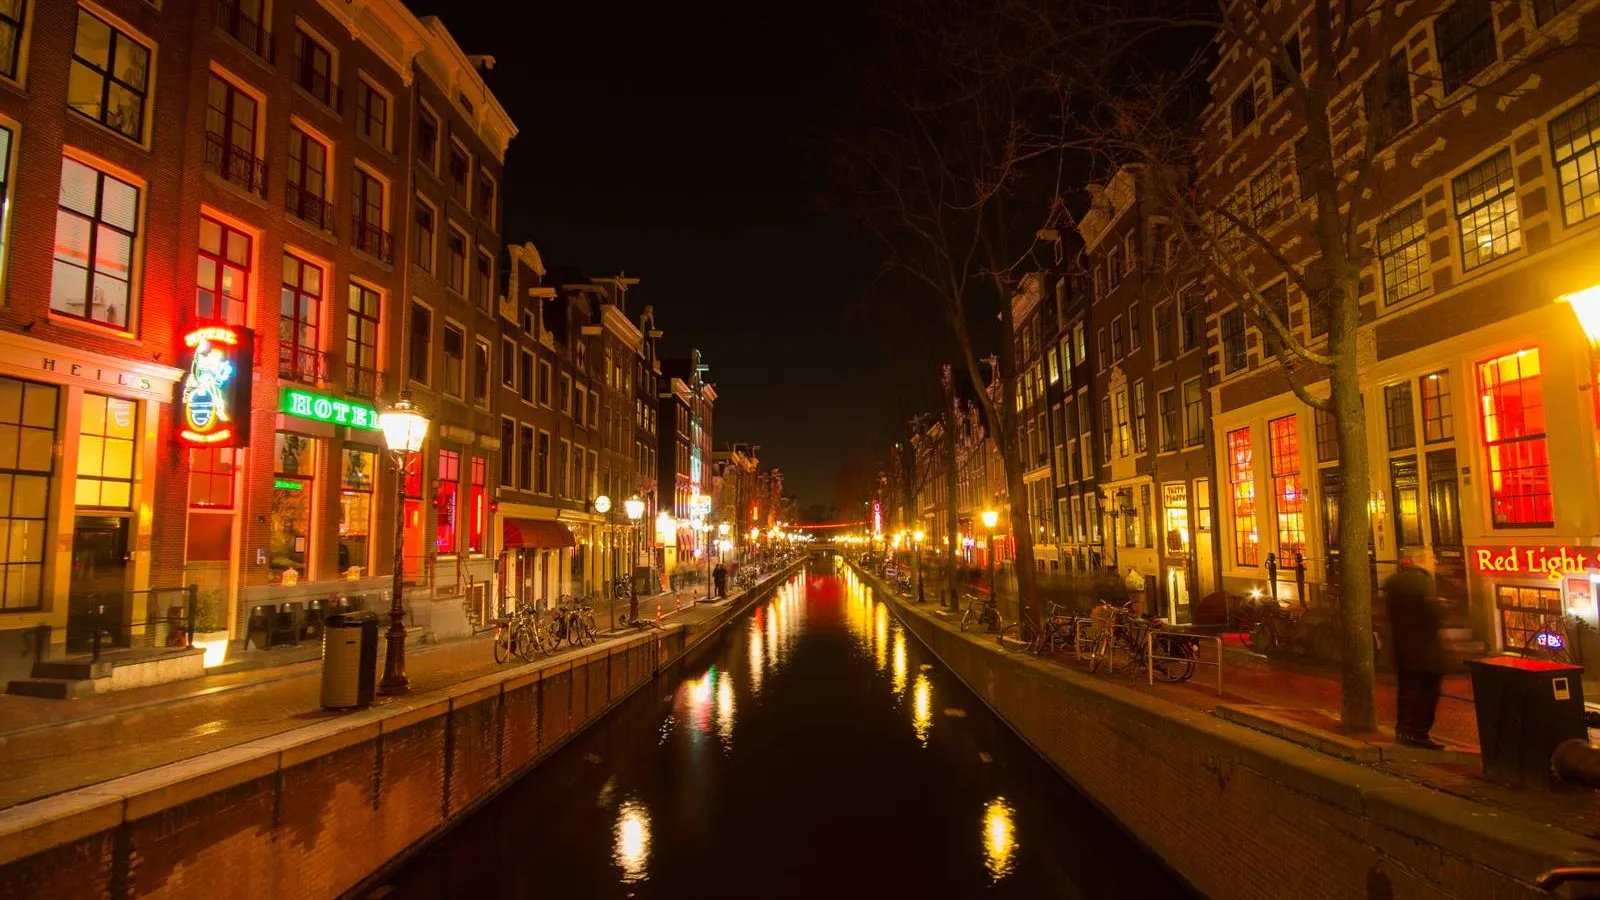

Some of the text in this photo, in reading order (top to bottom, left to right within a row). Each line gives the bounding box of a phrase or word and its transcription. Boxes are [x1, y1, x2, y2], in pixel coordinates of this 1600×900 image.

[42, 357, 151, 391] HEILS
[290, 392, 383, 430] HOTEL
[1477, 547, 1519, 572] Red
[1526, 546, 1588, 581] Light
